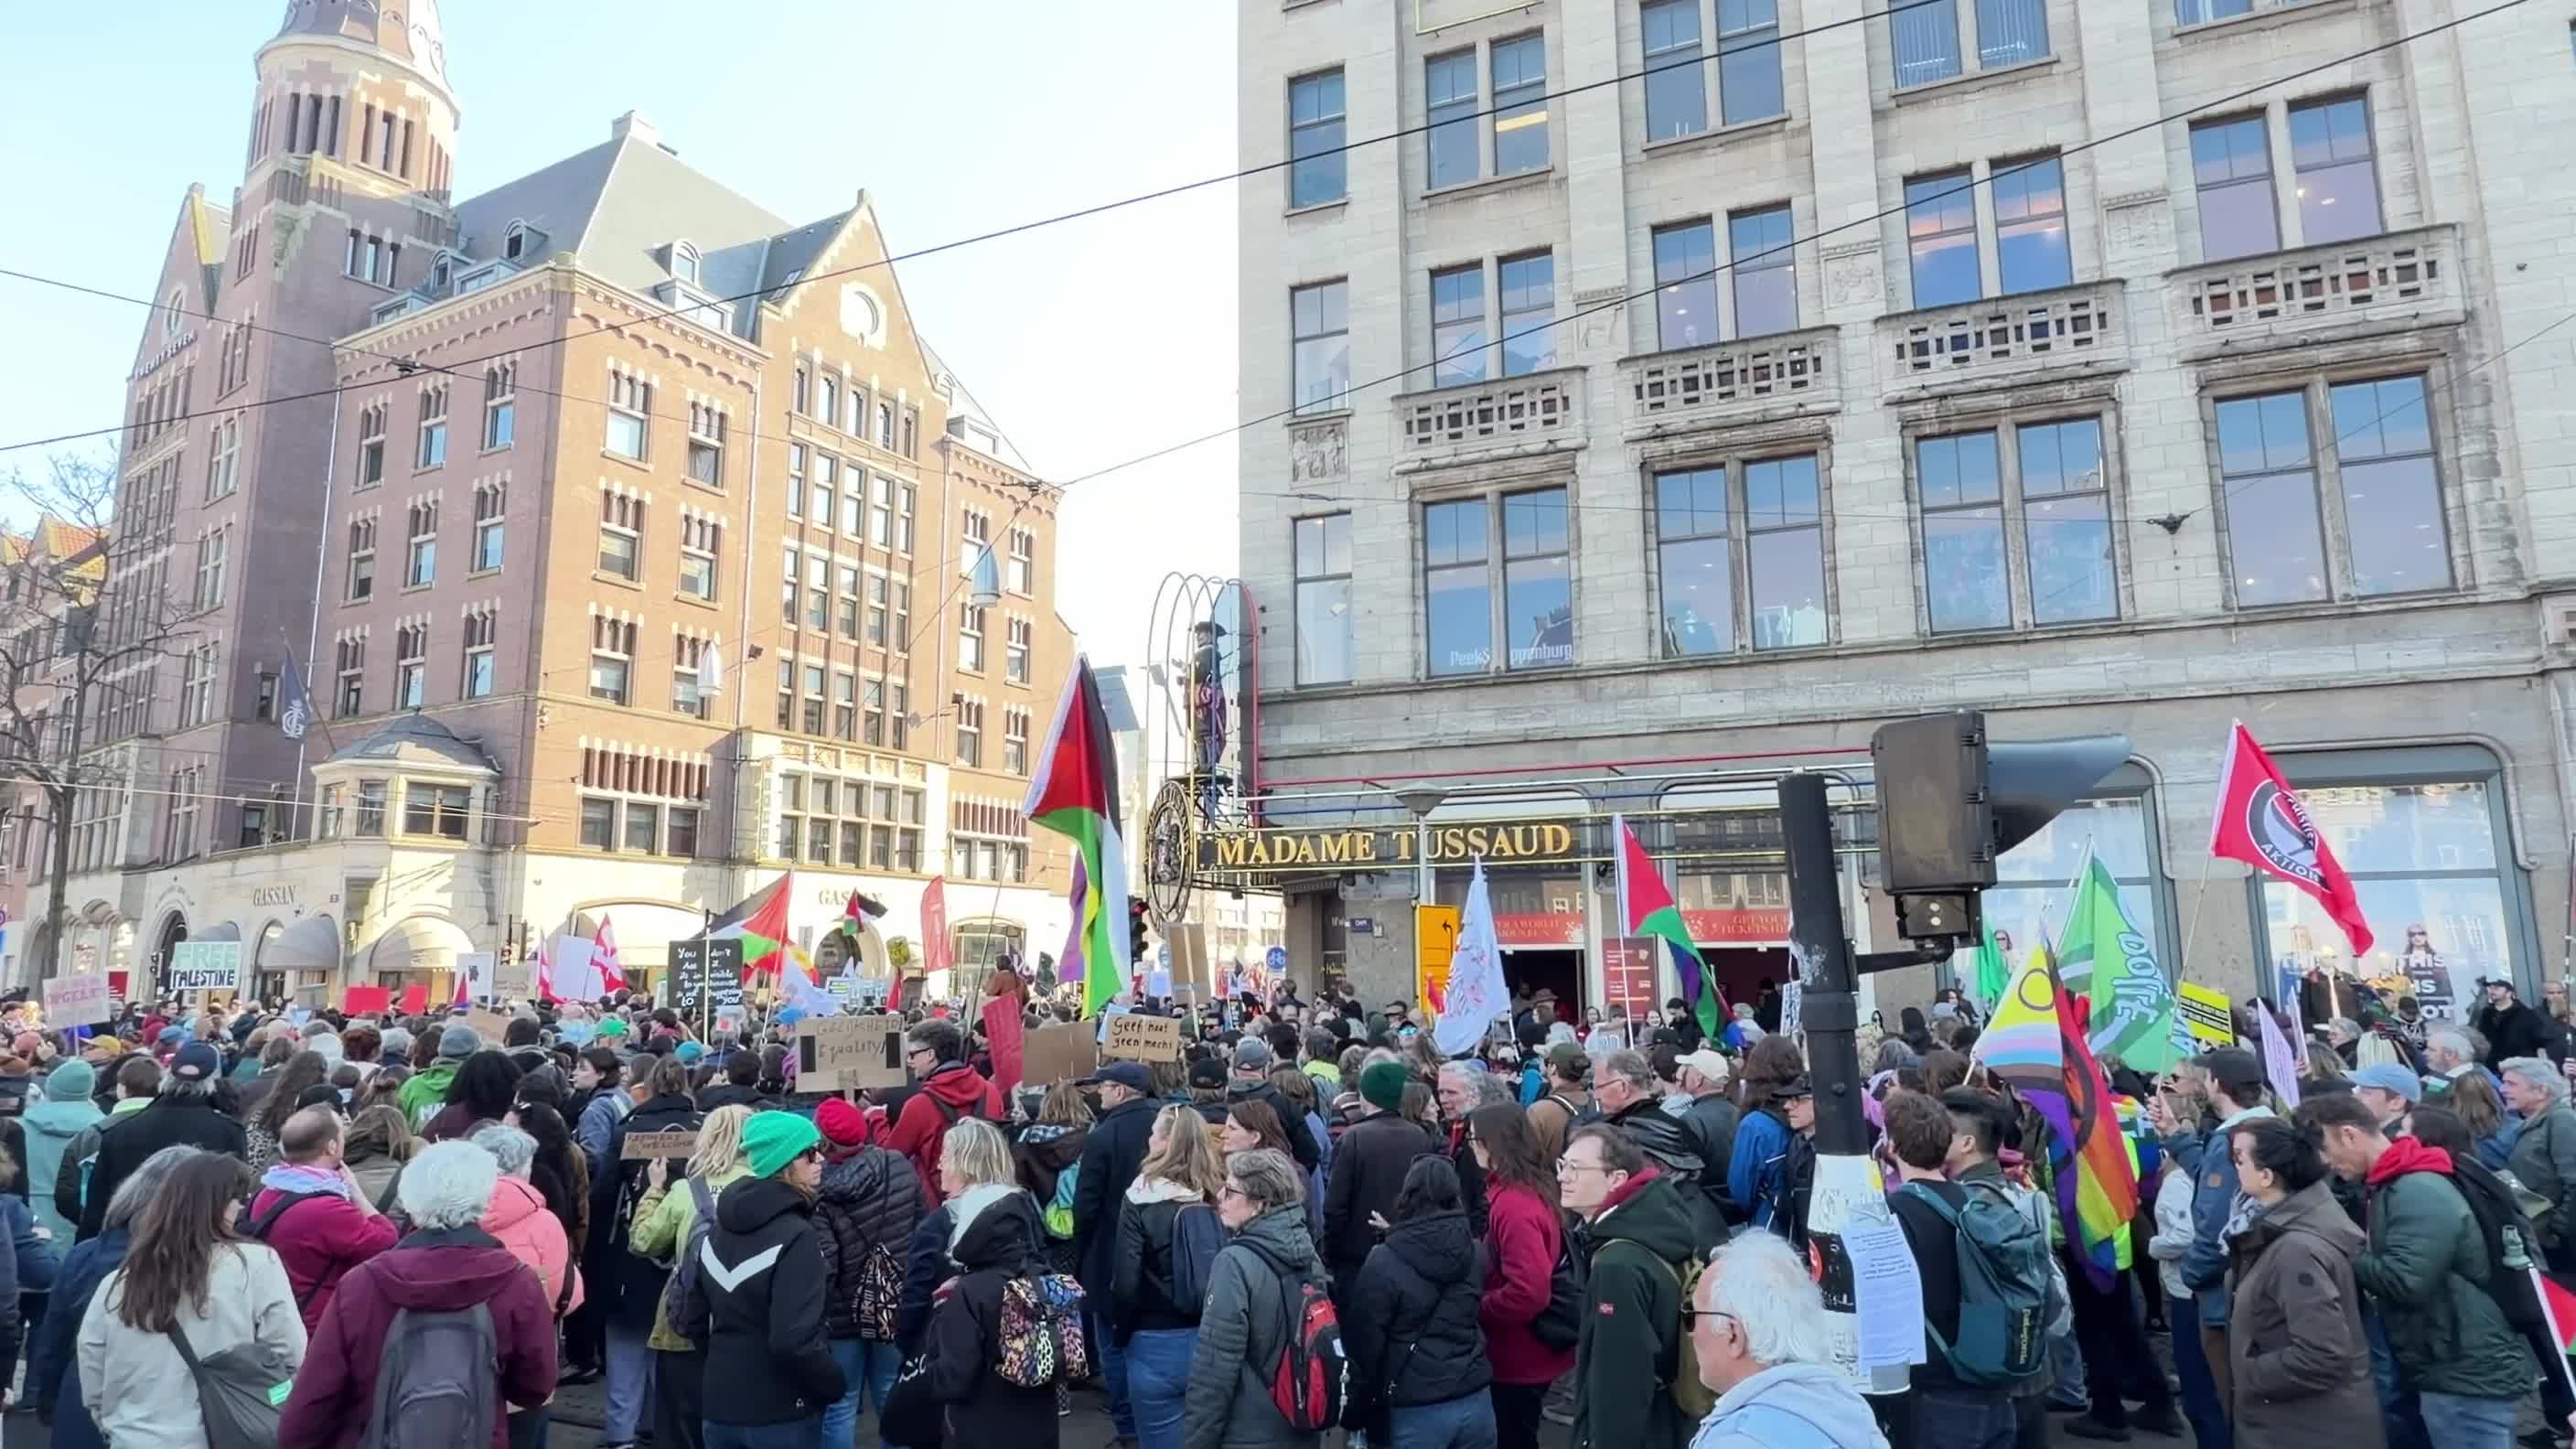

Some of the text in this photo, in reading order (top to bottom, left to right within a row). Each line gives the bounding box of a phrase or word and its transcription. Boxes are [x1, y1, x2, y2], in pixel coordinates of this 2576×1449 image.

[1216, 823, 1572, 865] MADAME TUSSAUD
[2260, 843, 2320, 881] AKTION
[252, 885, 296, 907] GASSAN
[175, 943, 236, 968] FREE
[172, 969, 235, 987] PALESTINE
[2424, 1004, 2453, 1020] OT
